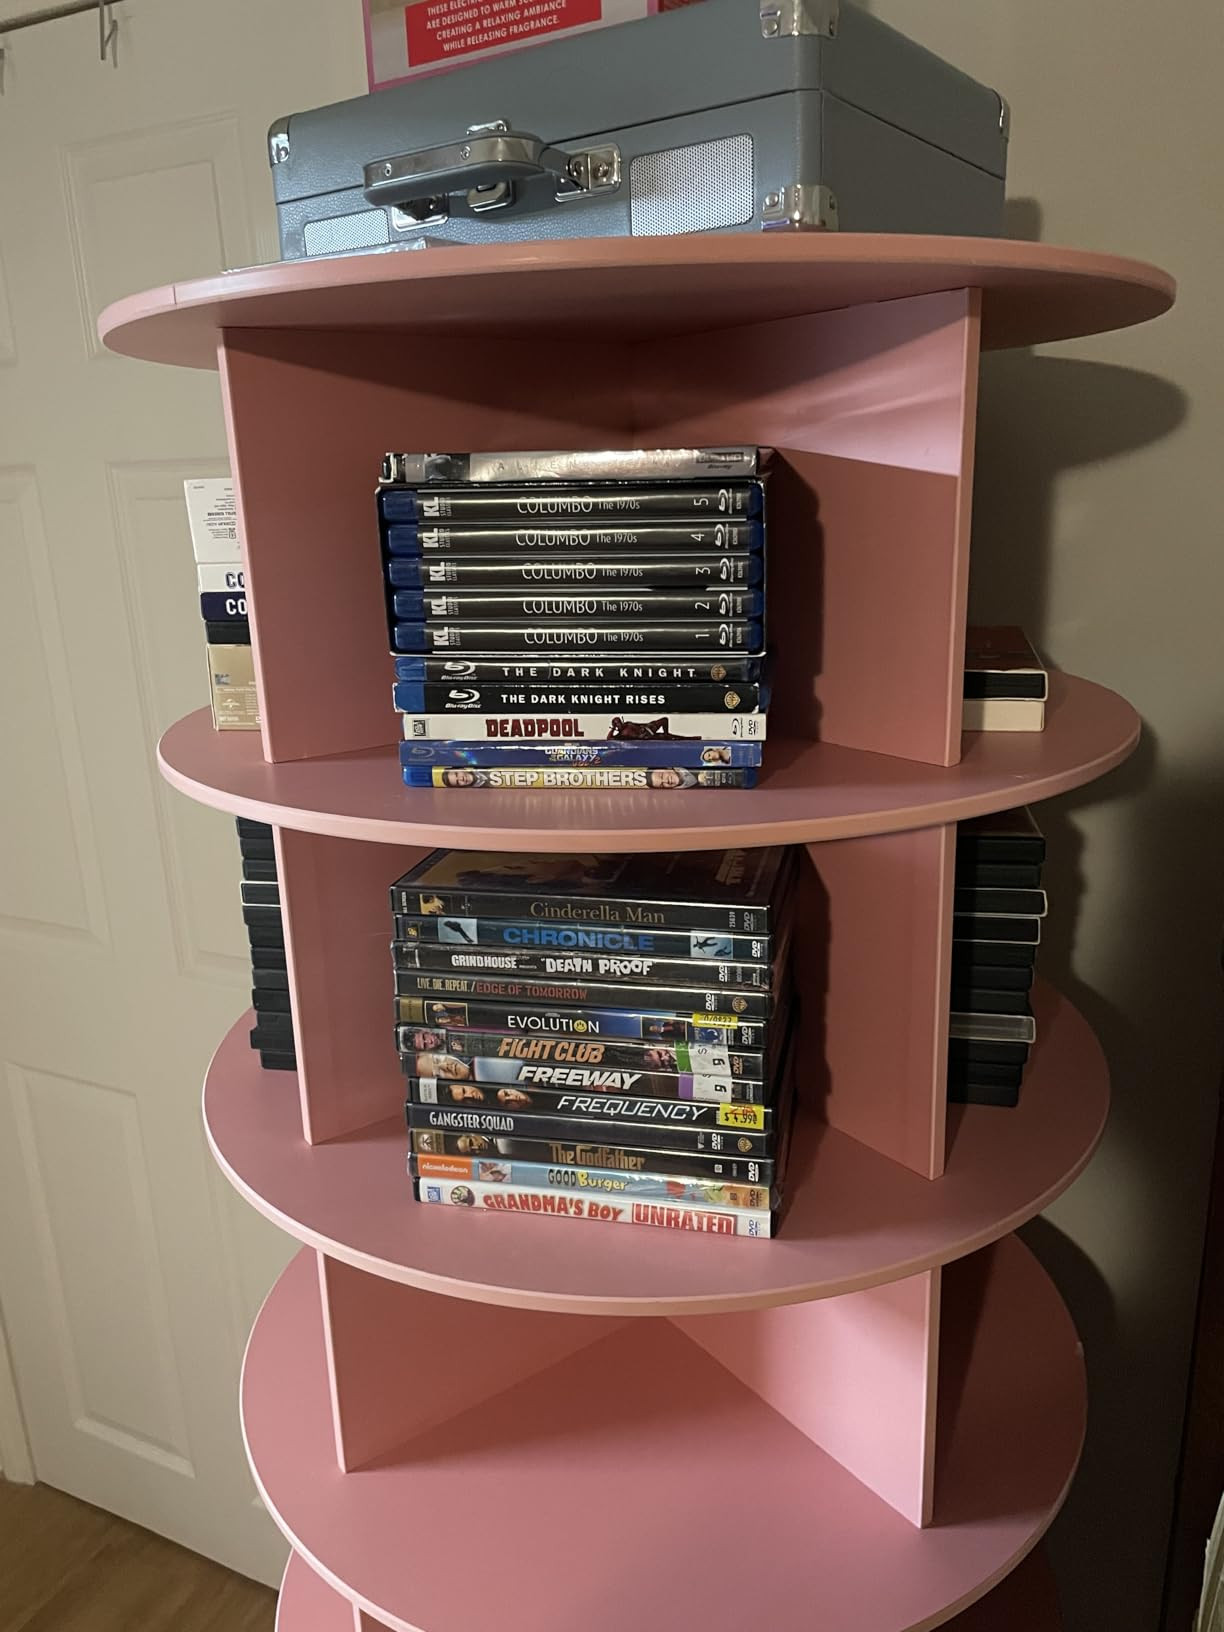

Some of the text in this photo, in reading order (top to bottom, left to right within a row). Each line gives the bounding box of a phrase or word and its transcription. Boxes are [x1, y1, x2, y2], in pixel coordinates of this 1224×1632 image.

[426, 19, 440, 30] ARE
[442, 9, 479, 26] DESIGNED
[481, 6, 491, 16] TO
[427, 5, 448, 16] THESE
[436, 0, 567, 40] CREATING A RELAXING AMBIANCE
[443, 39, 465, 52] WHILE
[466, 28, 507, 46] RELEASING
[517, 496, 640, 514] COLUMBO The 1970s
[693, 498, 709, 506] 5
[516, 529, 637, 546] COLUMBO The 1970s
[690, 533, 704, 542] 4
[521, 563, 643, 580] COLUMBO The 1970s
[695, 567, 710, 575] 3
[523, 597, 643, 614] COLUMBO The 1970s
[695, 602, 710, 610] 2
[524, 628, 643, 644] COLUMBO The 1970s
[502, 667, 696, 678] THE DARK KNIGHT
[501, 694, 666, 704] THE DARK KNIGHT RISES
[486, 718, 584, 737] DEADPOOL
[557, 754, 597, 762] GALAXY
[490, 771, 648, 788] STEP BROTHERS
[530, 901, 665, 924] Cinderella Man
[502, 927, 655, 951] CHRONICLE
[451, 954, 517, 969] GRINDHOUSE
[476, 982, 505, 995] EDGE
[508, 984, 522, 996] OF
[526, 985, 588, 1000] TOMORROW
[499, 1037, 606, 1064] FIGHT CLUB
[518, 1065, 643, 1090] FREEWAY
[557, 1095, 708, 1121] FREQUENCY
[429, 1111, 514, 1132] GANGSTER SQUAD
[549, 1142, 646, 1174] The Godfather
[547, 1168, 629, 1192] GOOD Burger
[747, 1162, 755, 1182] DVD
[482, 1193, 736, 1235] GRANDMA'S BOY UNRATED
